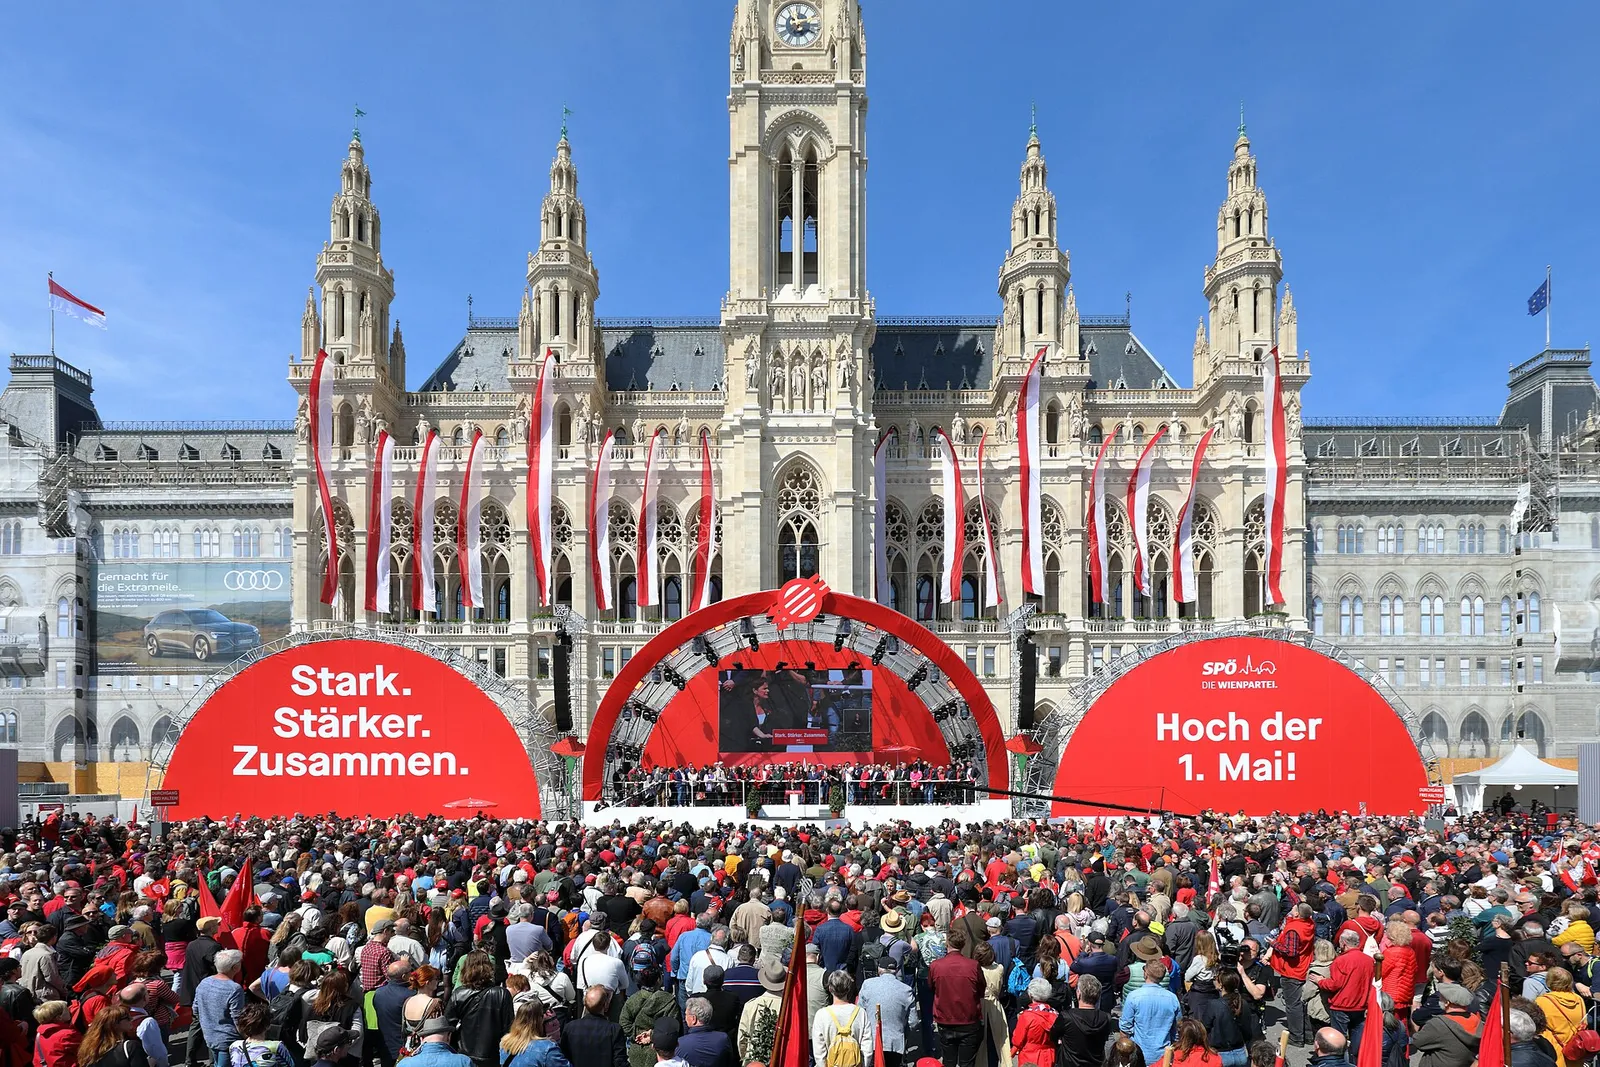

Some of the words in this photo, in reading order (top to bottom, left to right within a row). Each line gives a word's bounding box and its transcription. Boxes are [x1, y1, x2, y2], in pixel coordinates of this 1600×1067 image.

[97, 572, 149, 581] Gemacht
[151, 572, 169, 581] für
[97, 583, 115, 592] die
[117, 583, 182, 592] Extrameile.
[291, 665, 411, 697] Stark.
[1202, 659, 1237, 675] SPÖ
[1202, 681, 1216, 689] DIE
[1218, 680, 1278, 689] WIENPARTEI.
[273, 707, 430, 739] Stärker.
[1157, 711, 1249, 742] Hoch
[1261, 711, 1322, 742] der
[233, 745, 468, 776] Zusammen.
[1179, 753, 1204, 781] 1.
[1219, 750, 1295, 782] Mai!
